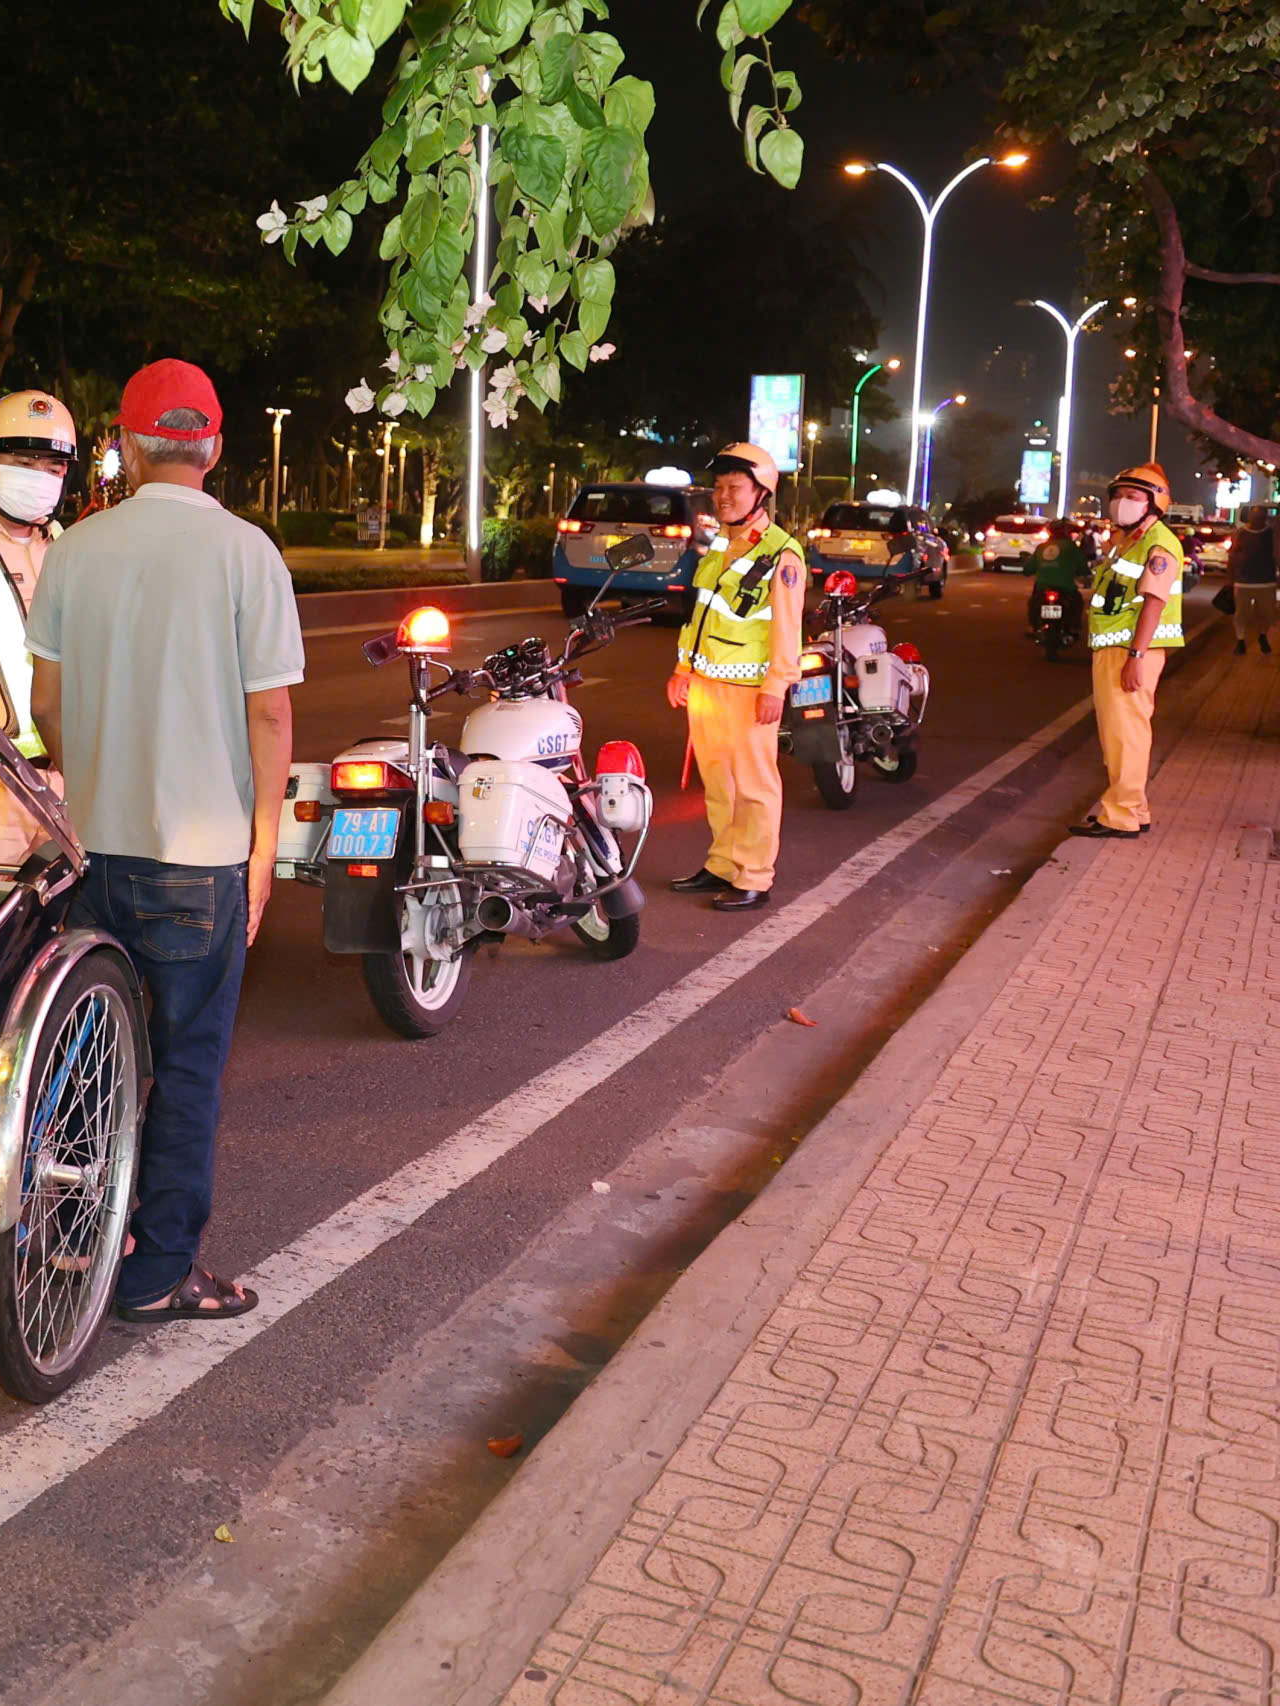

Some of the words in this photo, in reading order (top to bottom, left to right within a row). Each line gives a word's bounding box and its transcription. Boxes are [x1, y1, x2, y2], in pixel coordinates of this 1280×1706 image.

[537, 733, 569, 755] CSGT
[341, 812, 390, 833] 79-A1
[331, 834, 393, 856] 000.73
